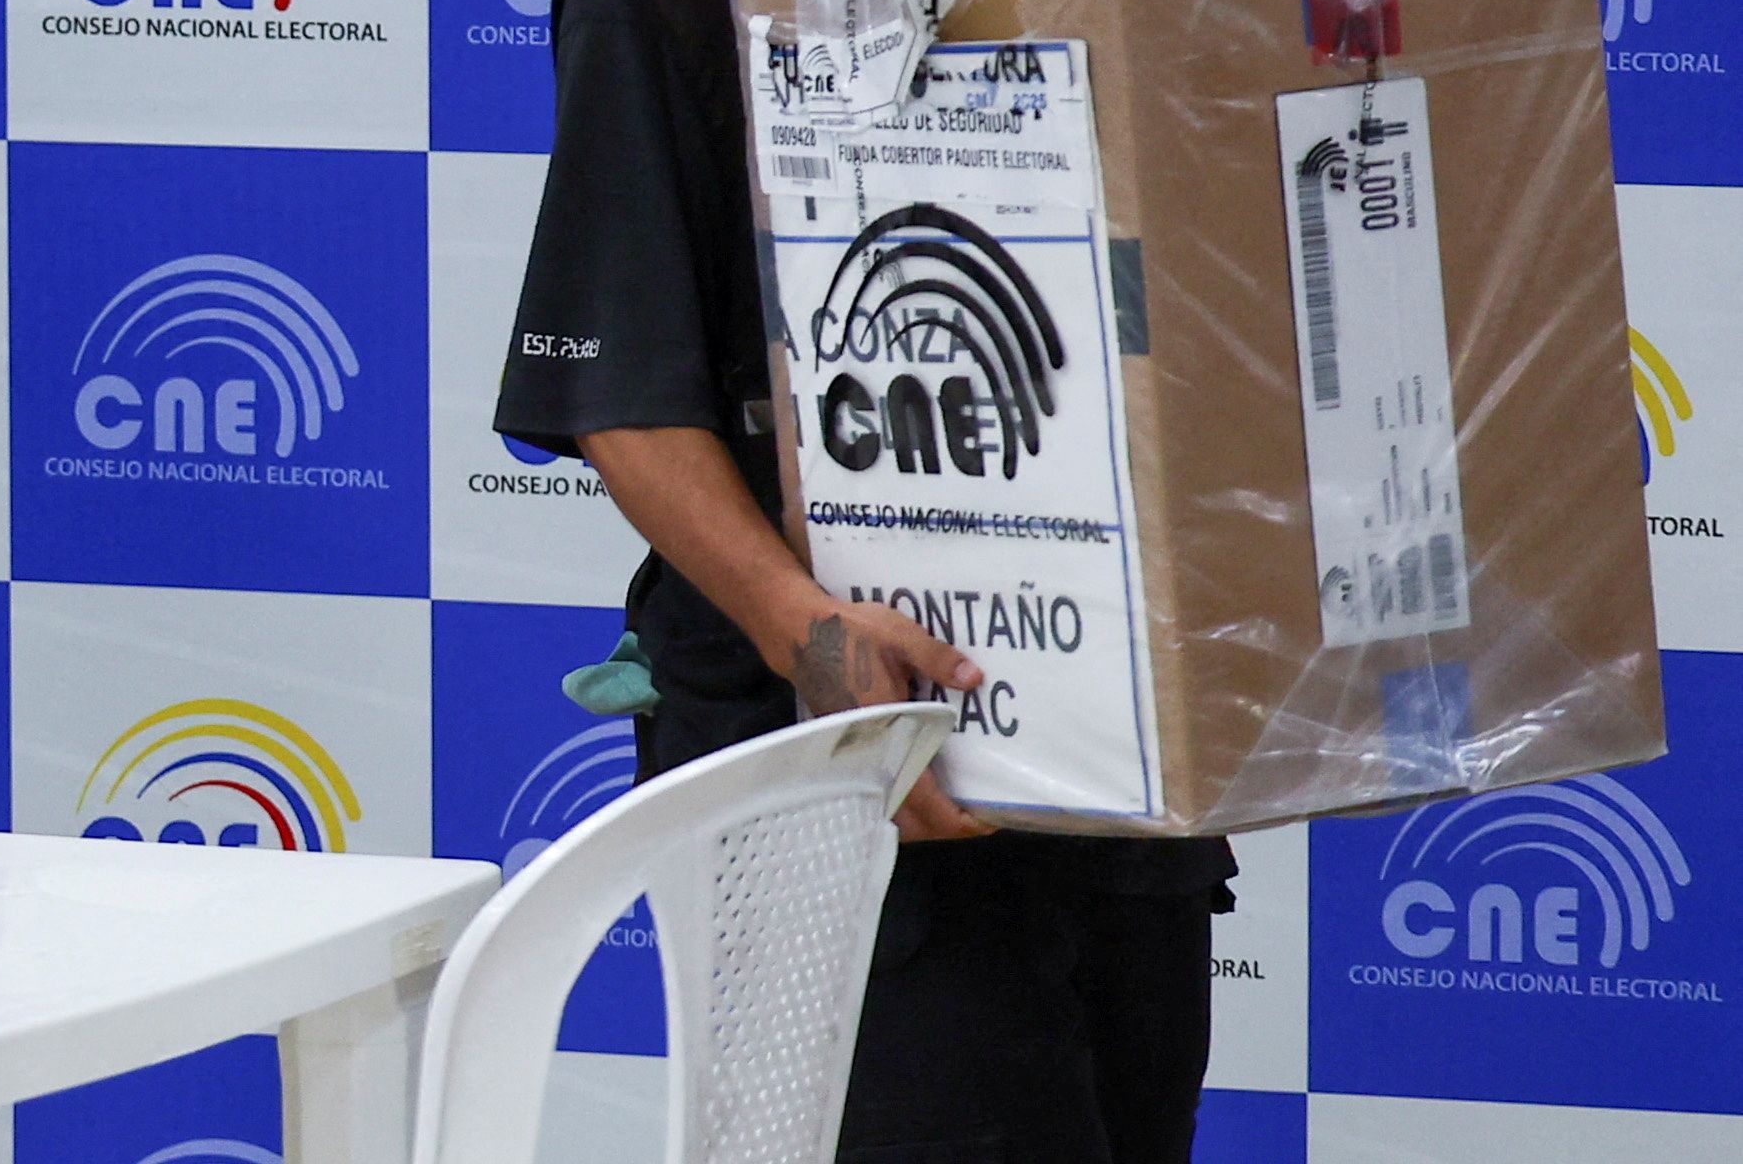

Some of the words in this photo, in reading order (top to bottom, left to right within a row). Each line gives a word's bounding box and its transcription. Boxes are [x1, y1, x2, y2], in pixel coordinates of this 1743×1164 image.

[42, 15, 141, 36] CONSEJO
[146, 18, 259, 39] NACIONAL
[265, 20, 388, 42] ELECTORAL
[466, 25, 551, 46] CONSEJ
[1605, 51, 1726, 74] LECTORAL
[838, 143, 879, 164] FUNDA
[881, 145, 944, 167] COBERTOR
[946, 147, 999, 169] PAQUETE
[1002, 149, 1072, 172] ELECTORAL
[521, 332, 558, 358] EST.
[74, 374, 257, 455] CNE
[44, 457, 143, 479] CONSEJO
[148, 461, 261, 484] NACIONAL
[266, 465, 390, 489] ELECTORAL
[468, 473, 570, 496] CONSEJO
[809, 500, 897, 530] CONSEJO
[900, 506, 988, 536] NACIONAL
[992, 513, 1111, 544] ELECTORAL
[1647, 516, 1725, 538] TORAL
[850, 579, 1083, 654] ONTAÑO
[1381, 880, 1579, 966] CNE
[1348, 965, 1455, 989] CONSEJO
[1462, 970, 1584, 995] NACIONAL
[1590, 976, 1723, 1002] ELECTORAL
